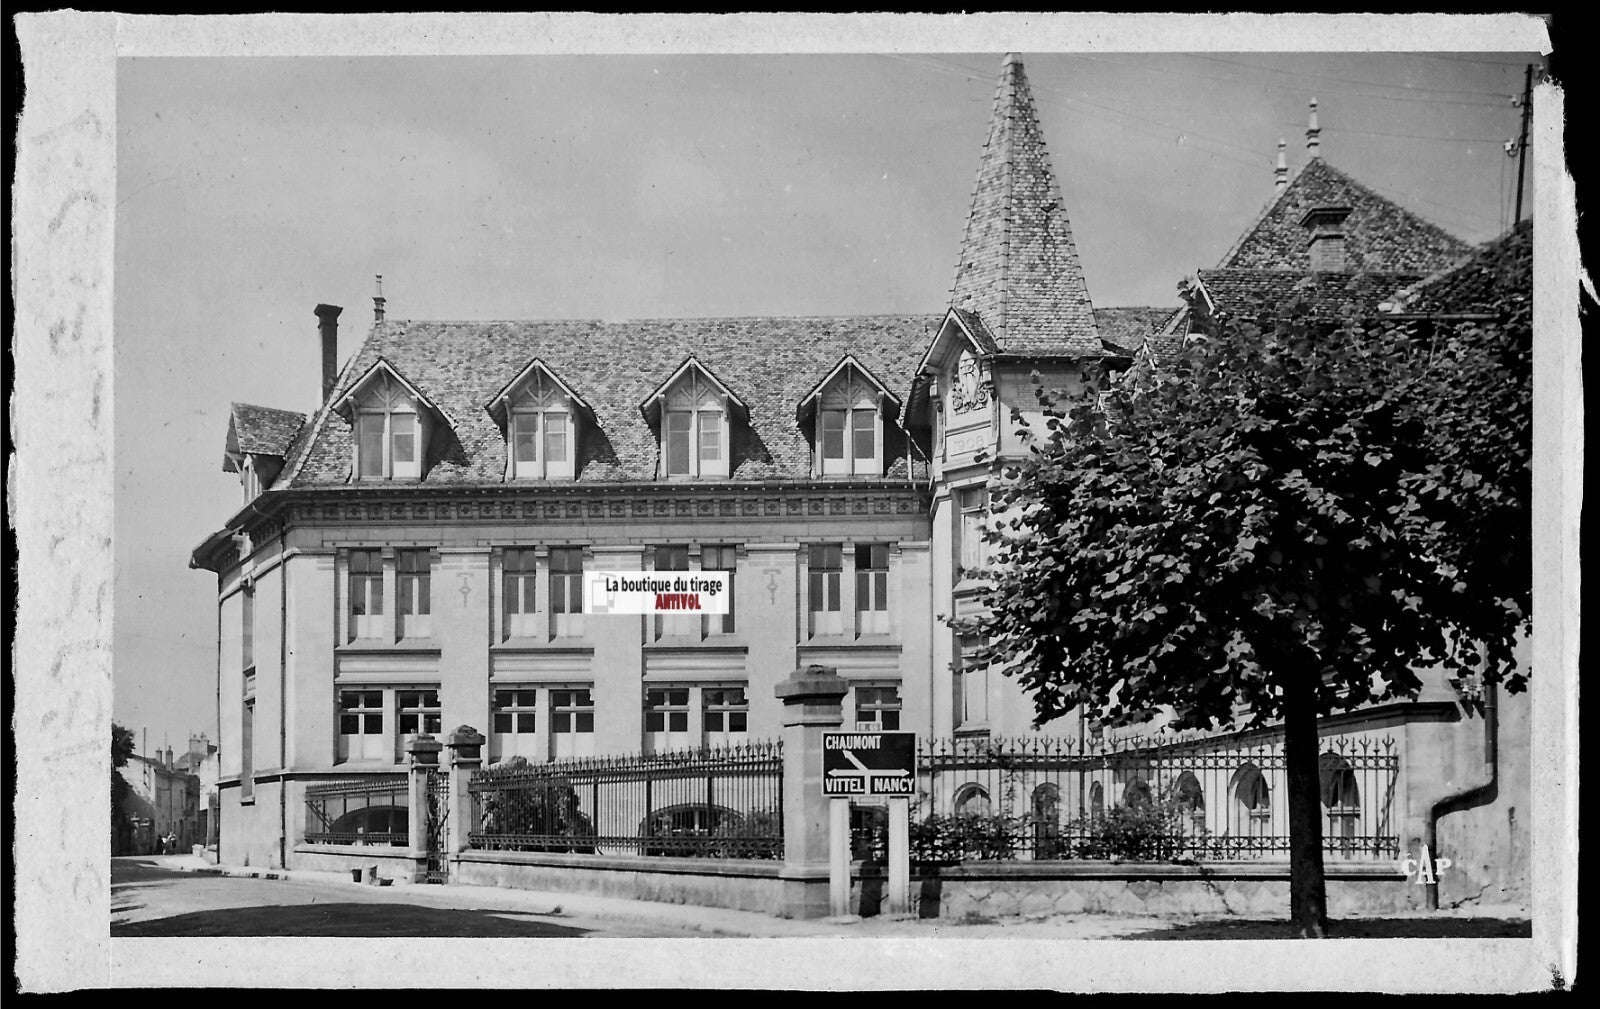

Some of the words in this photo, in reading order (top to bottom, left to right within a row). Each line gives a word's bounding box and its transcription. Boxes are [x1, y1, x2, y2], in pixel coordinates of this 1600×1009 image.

[825, 735, 881, 750] CHAUMONT
[825, 778, 865, 793] VITTEL
[874, 778, 914, 792] NANCY
